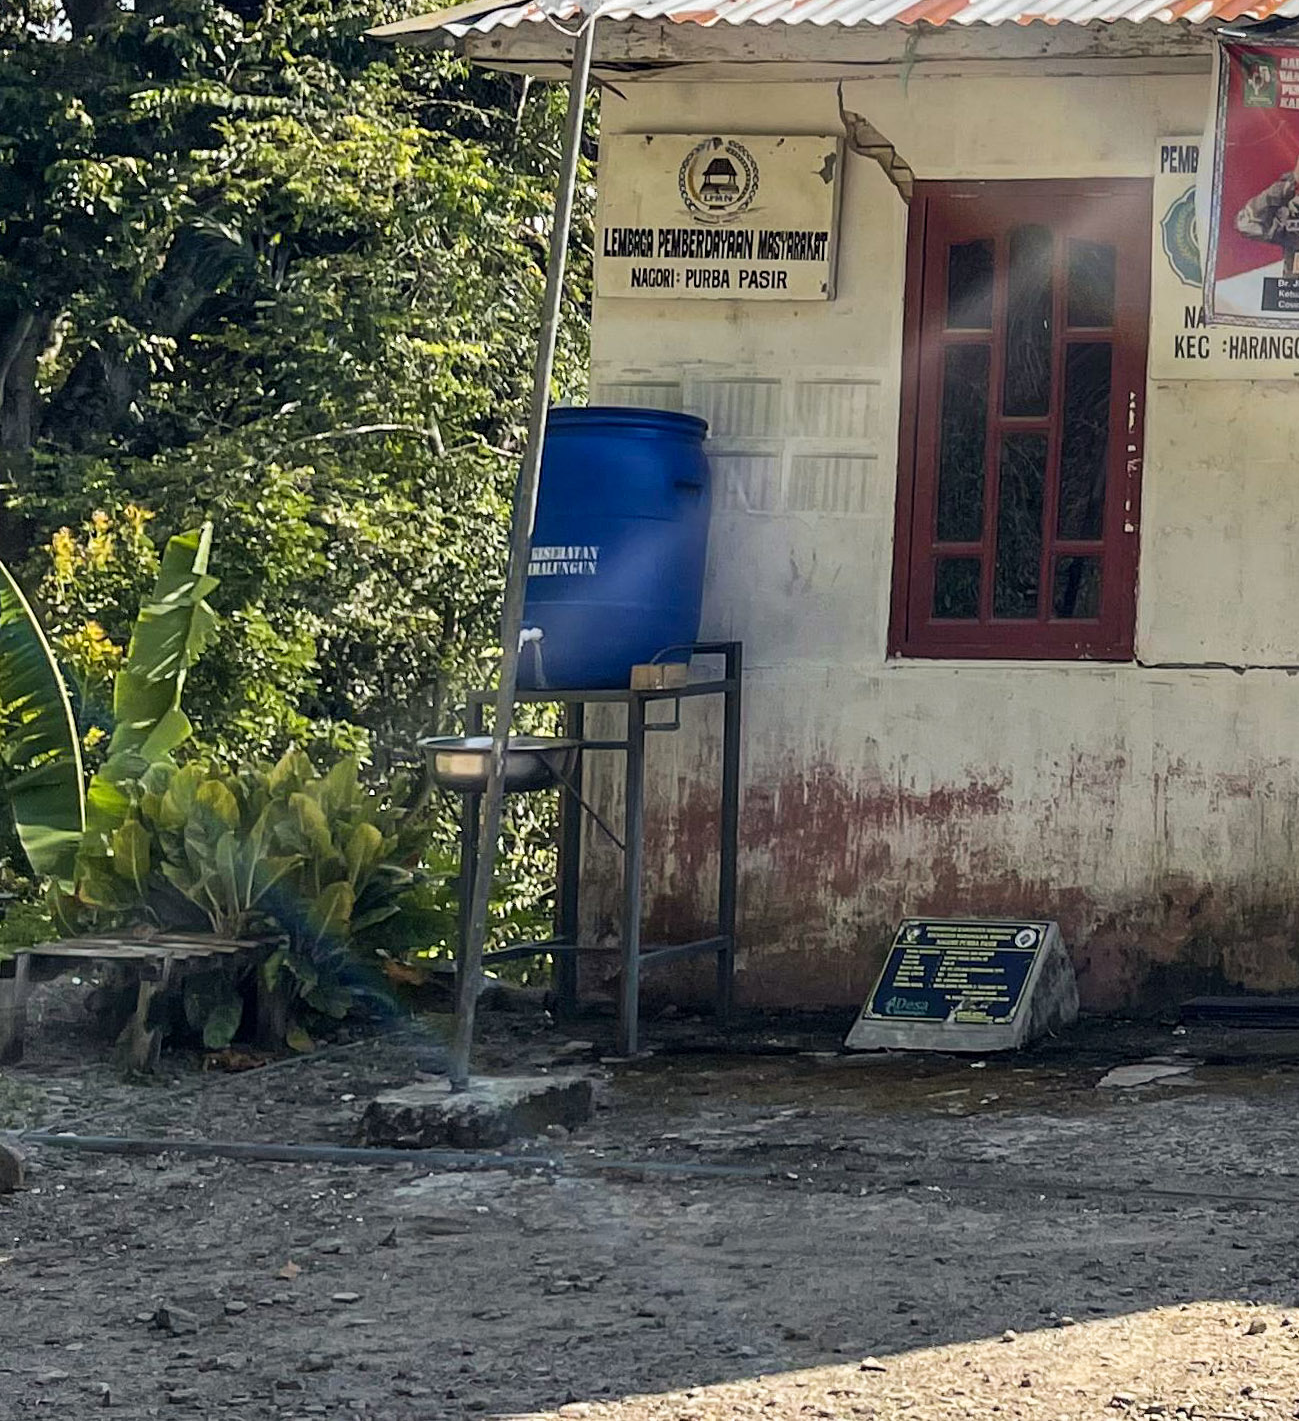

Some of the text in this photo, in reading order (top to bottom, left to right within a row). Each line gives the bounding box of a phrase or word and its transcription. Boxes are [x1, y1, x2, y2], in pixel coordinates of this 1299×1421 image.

[604, 228, 828, 261] LEMBAGA PEMBERDAYAAN MASYARAKAT
[685, 269, 730, 288] PURBA
[738, 271, 788, 289] PASIR
[1175, 335, 1210, 360] KEC
